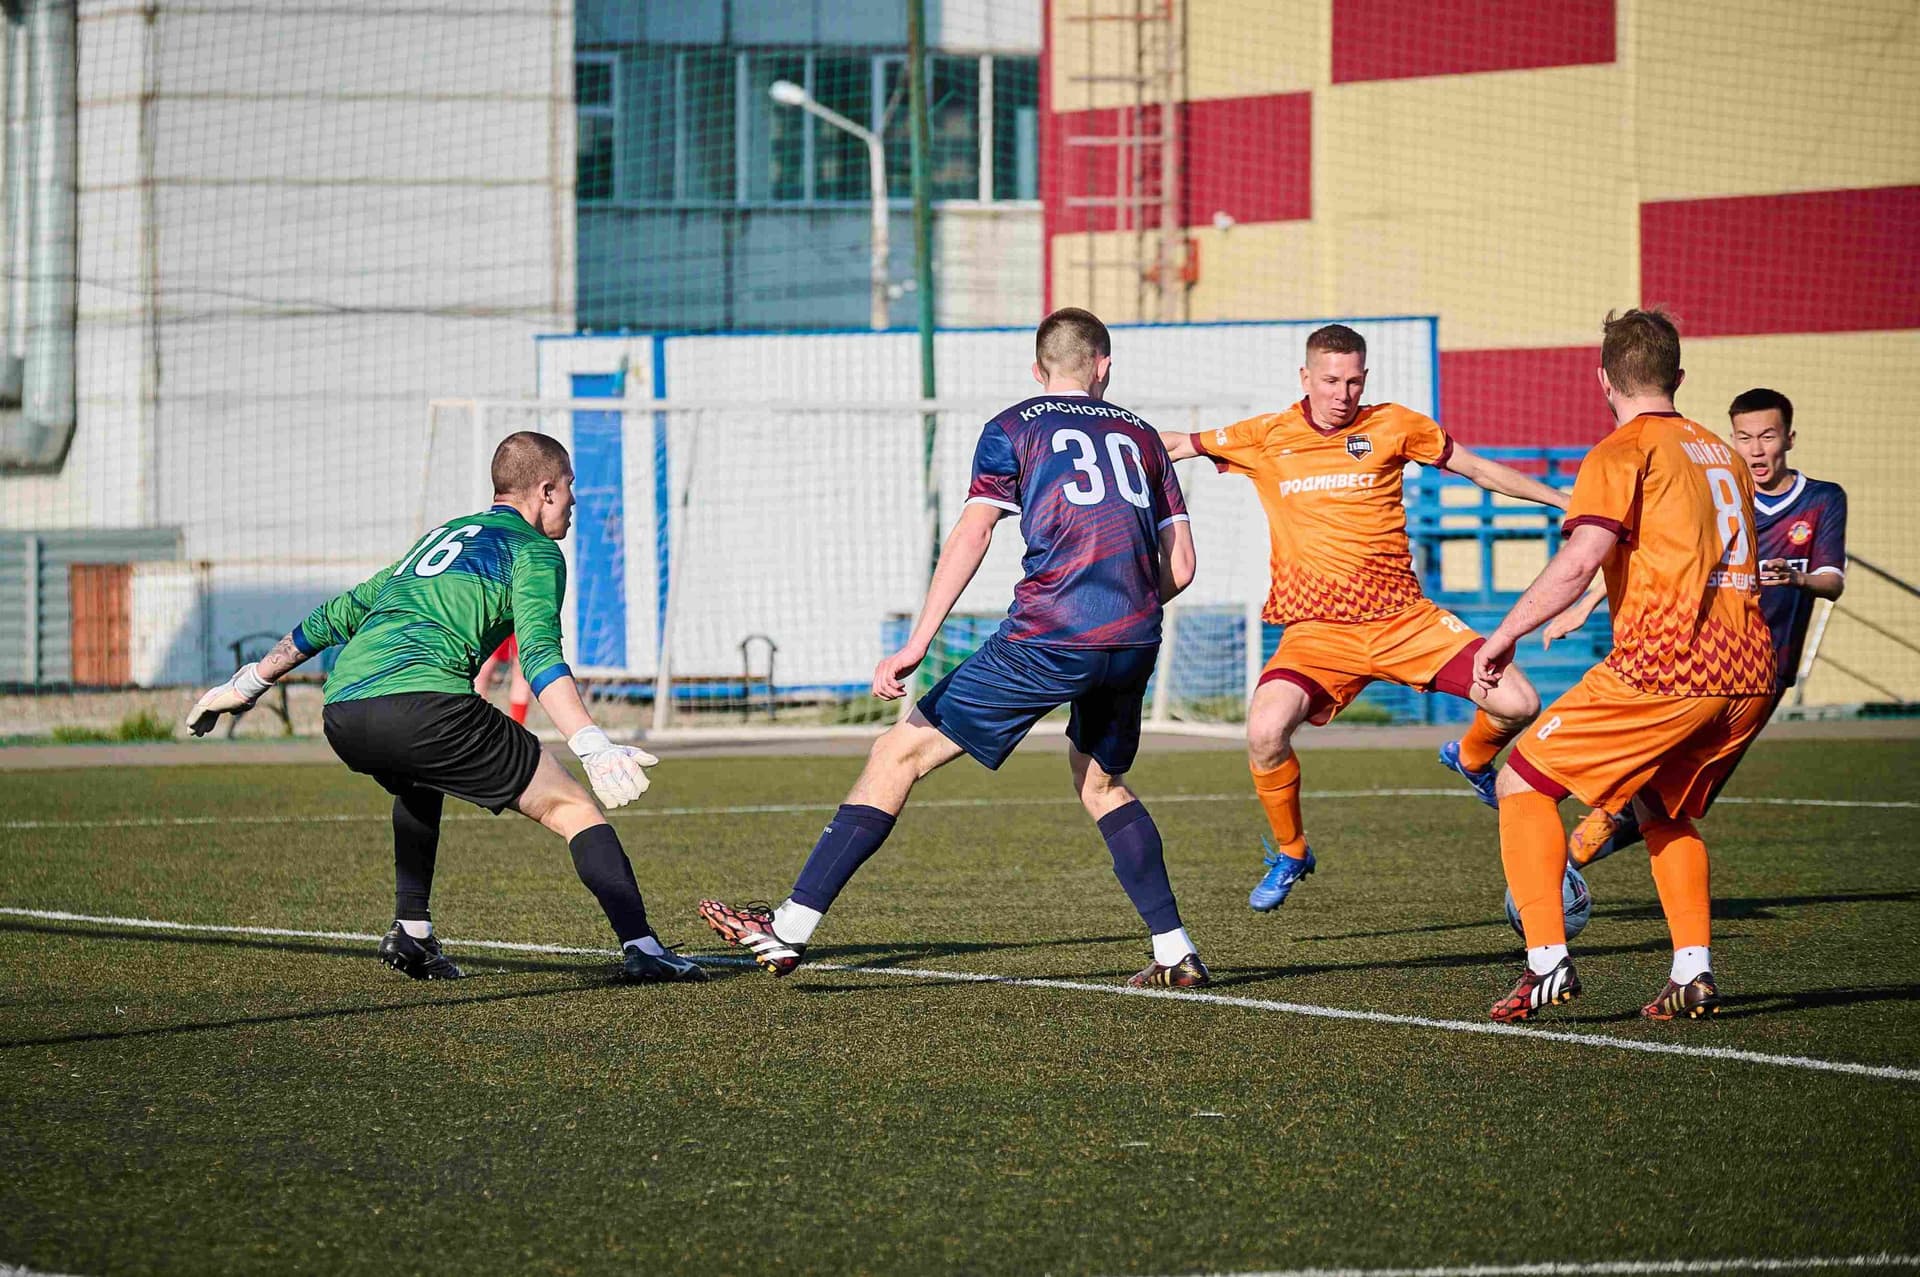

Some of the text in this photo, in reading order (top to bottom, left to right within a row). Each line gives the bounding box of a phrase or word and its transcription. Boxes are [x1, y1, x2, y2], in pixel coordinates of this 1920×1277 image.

[1020, 402, 1145, 430] КРАСНОЯРСК
[1051, 428, 1150, 509] 30
[1706, 468, 1749, 566] 8
[392, 524, 483, 577] 16
[1536, 716, 1561, 740] 8
